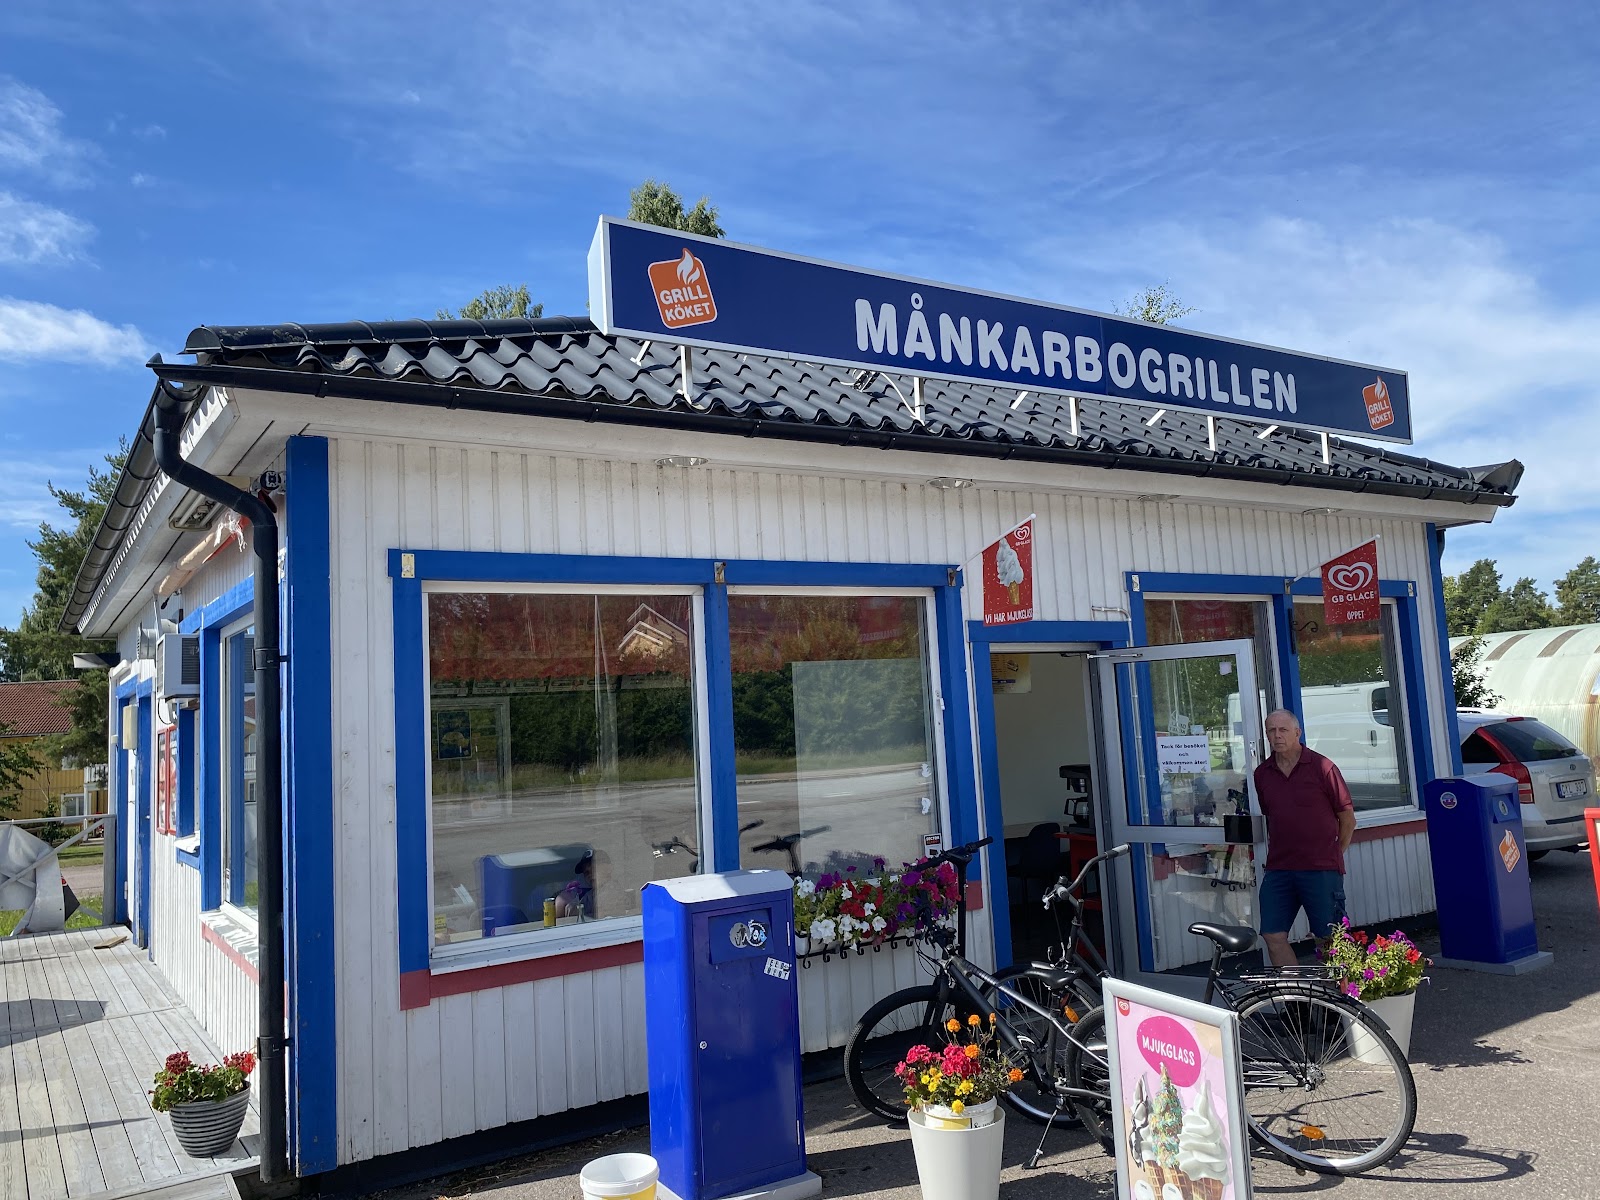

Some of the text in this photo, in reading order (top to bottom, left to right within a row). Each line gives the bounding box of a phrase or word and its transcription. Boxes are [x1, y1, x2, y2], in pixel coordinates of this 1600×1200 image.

[659, 285, 708, 305] GRILL
[665, 302, 710, 321] KÖKET
[854, 292, 1298, 414] MÅNKARBOGRILLEN
[1368, 400, 1389, 414] GRILL
[1371, 411, 1391, 426] KÖKET
[1331, 591, 1375, 603] GB GLACE
[993, 612, 1006, 623] HAR
[1346, 610, 1365, 620] ÖPPET
[1141, 1034, 1195, 1067] MJUKGLASS
